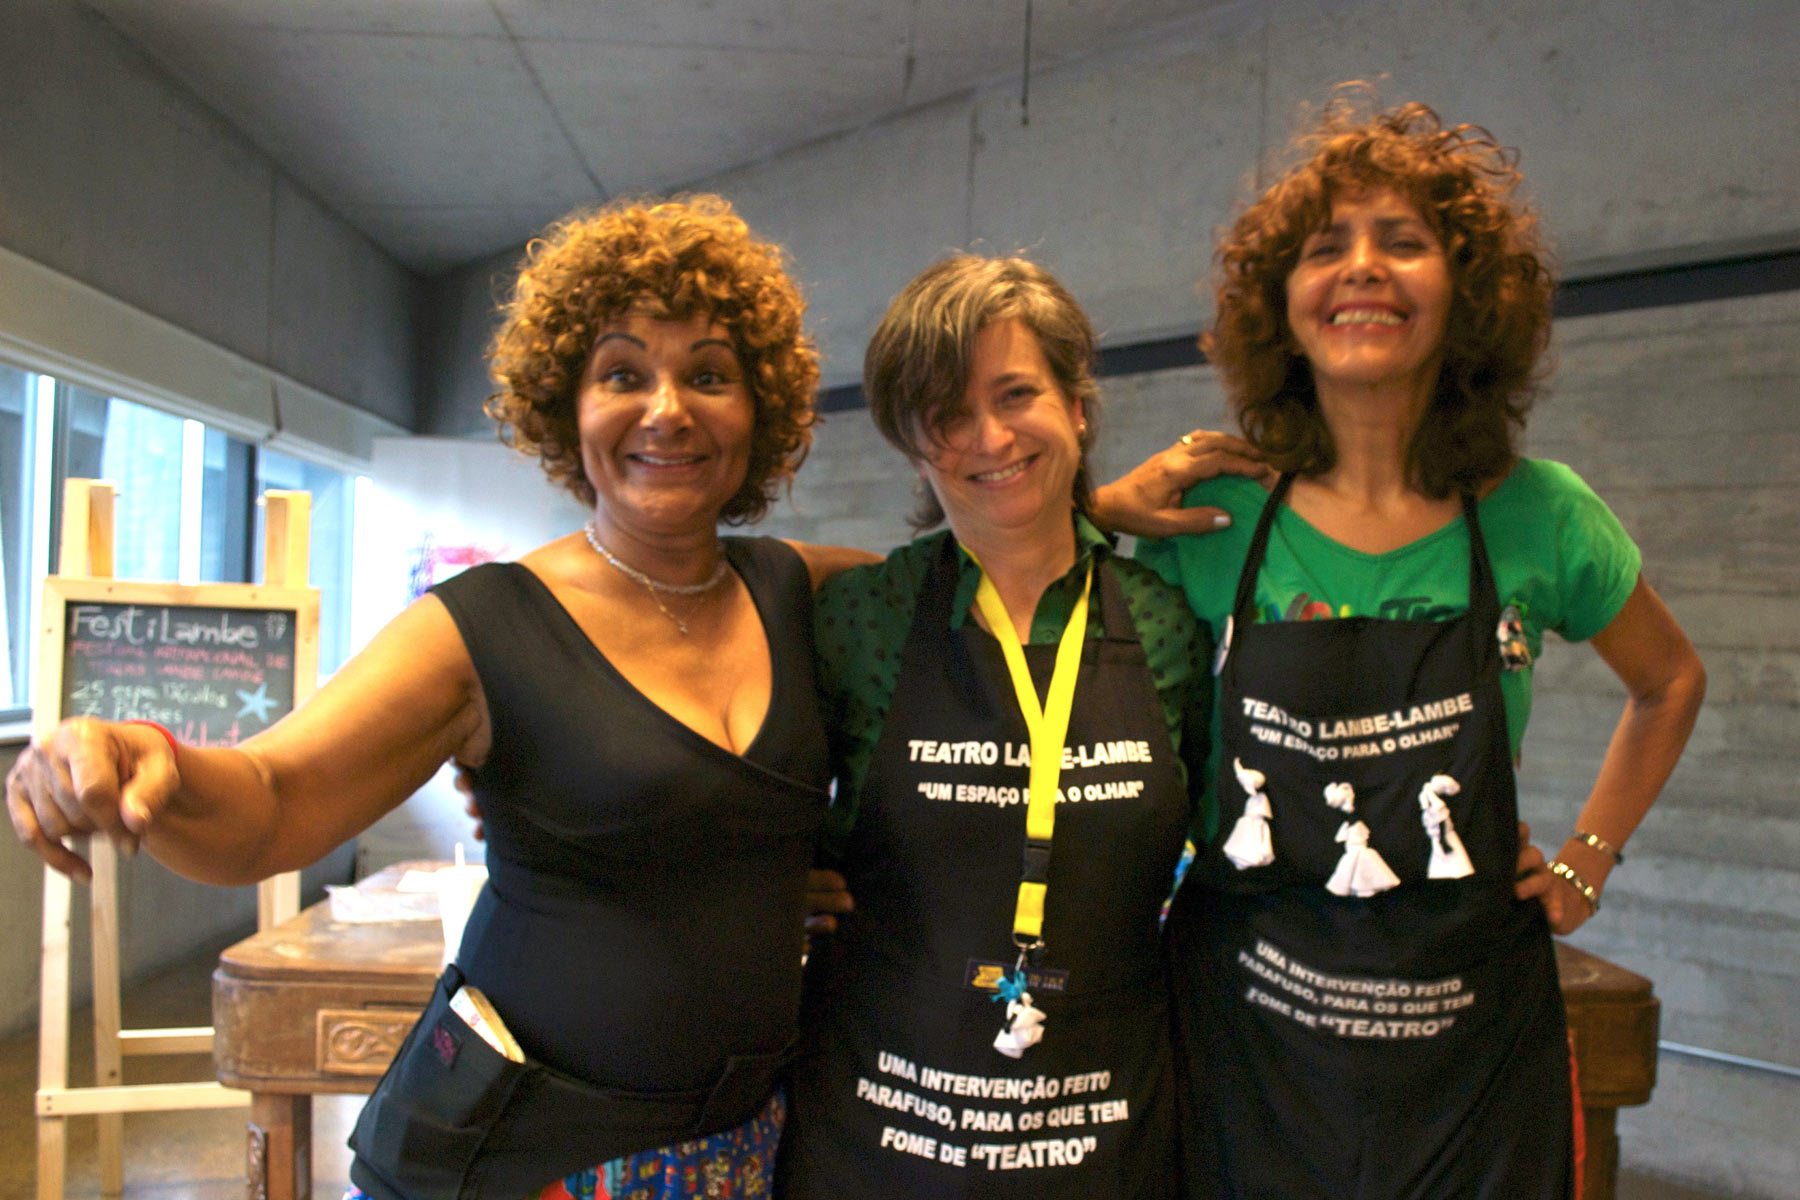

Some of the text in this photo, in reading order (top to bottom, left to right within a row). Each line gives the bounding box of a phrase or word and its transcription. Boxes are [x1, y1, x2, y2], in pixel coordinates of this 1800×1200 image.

[1242, 693, 1474, 739] TEATRO LAMBE-LAMBE
[908, 740, 1152, 769] TEATRO LAE-LAMBE
[1342, 742, 1381, 759] PARA
[1382, 739, 1397, 753] O
[918, 780, 1144, 807] “UM ESPAÇO PA O OLHAR”
[1238, 950, 1475, 1014] PARAFUSO, PARA OS QUE TEM
[1256, 940, 1463, 999] UMA INTERVENÇÃO FEITO
[1247, 986, 1455, 1039] FOME DE “TEATRO”
[877, 1050, 1111, 1104] UMA INTERVENÇÃO FEITO
[857, 1078, 1128, 1132] PARAFUSO, PARA OS QUE TEM
[881, 1126, 1096, 1170] FOME DE “TEATRO”
